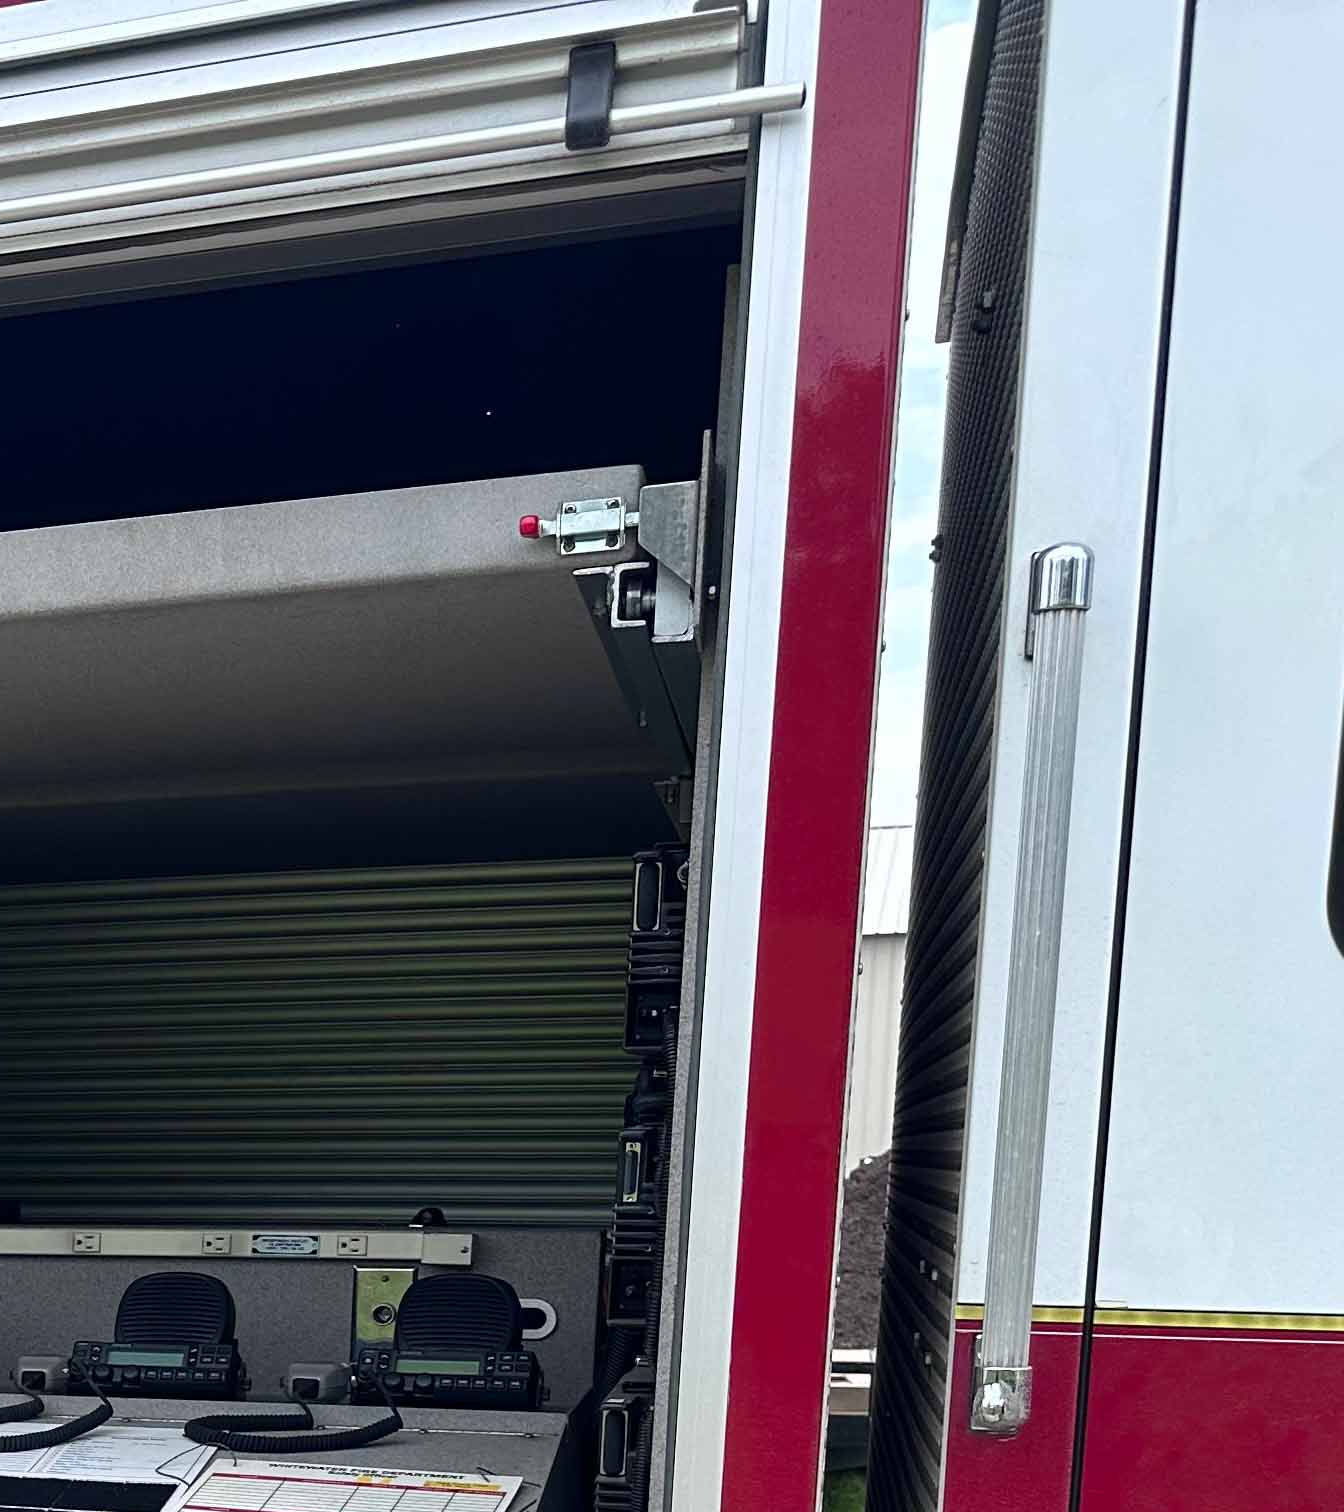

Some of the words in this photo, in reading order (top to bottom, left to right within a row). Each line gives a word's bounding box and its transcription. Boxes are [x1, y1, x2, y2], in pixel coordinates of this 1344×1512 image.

[268, 1463, 348, 1473] WHITEWATER
[350, 1467, 379, 1475] FIRE
[381, 1470, 465, 1480] DEPARTMENT
